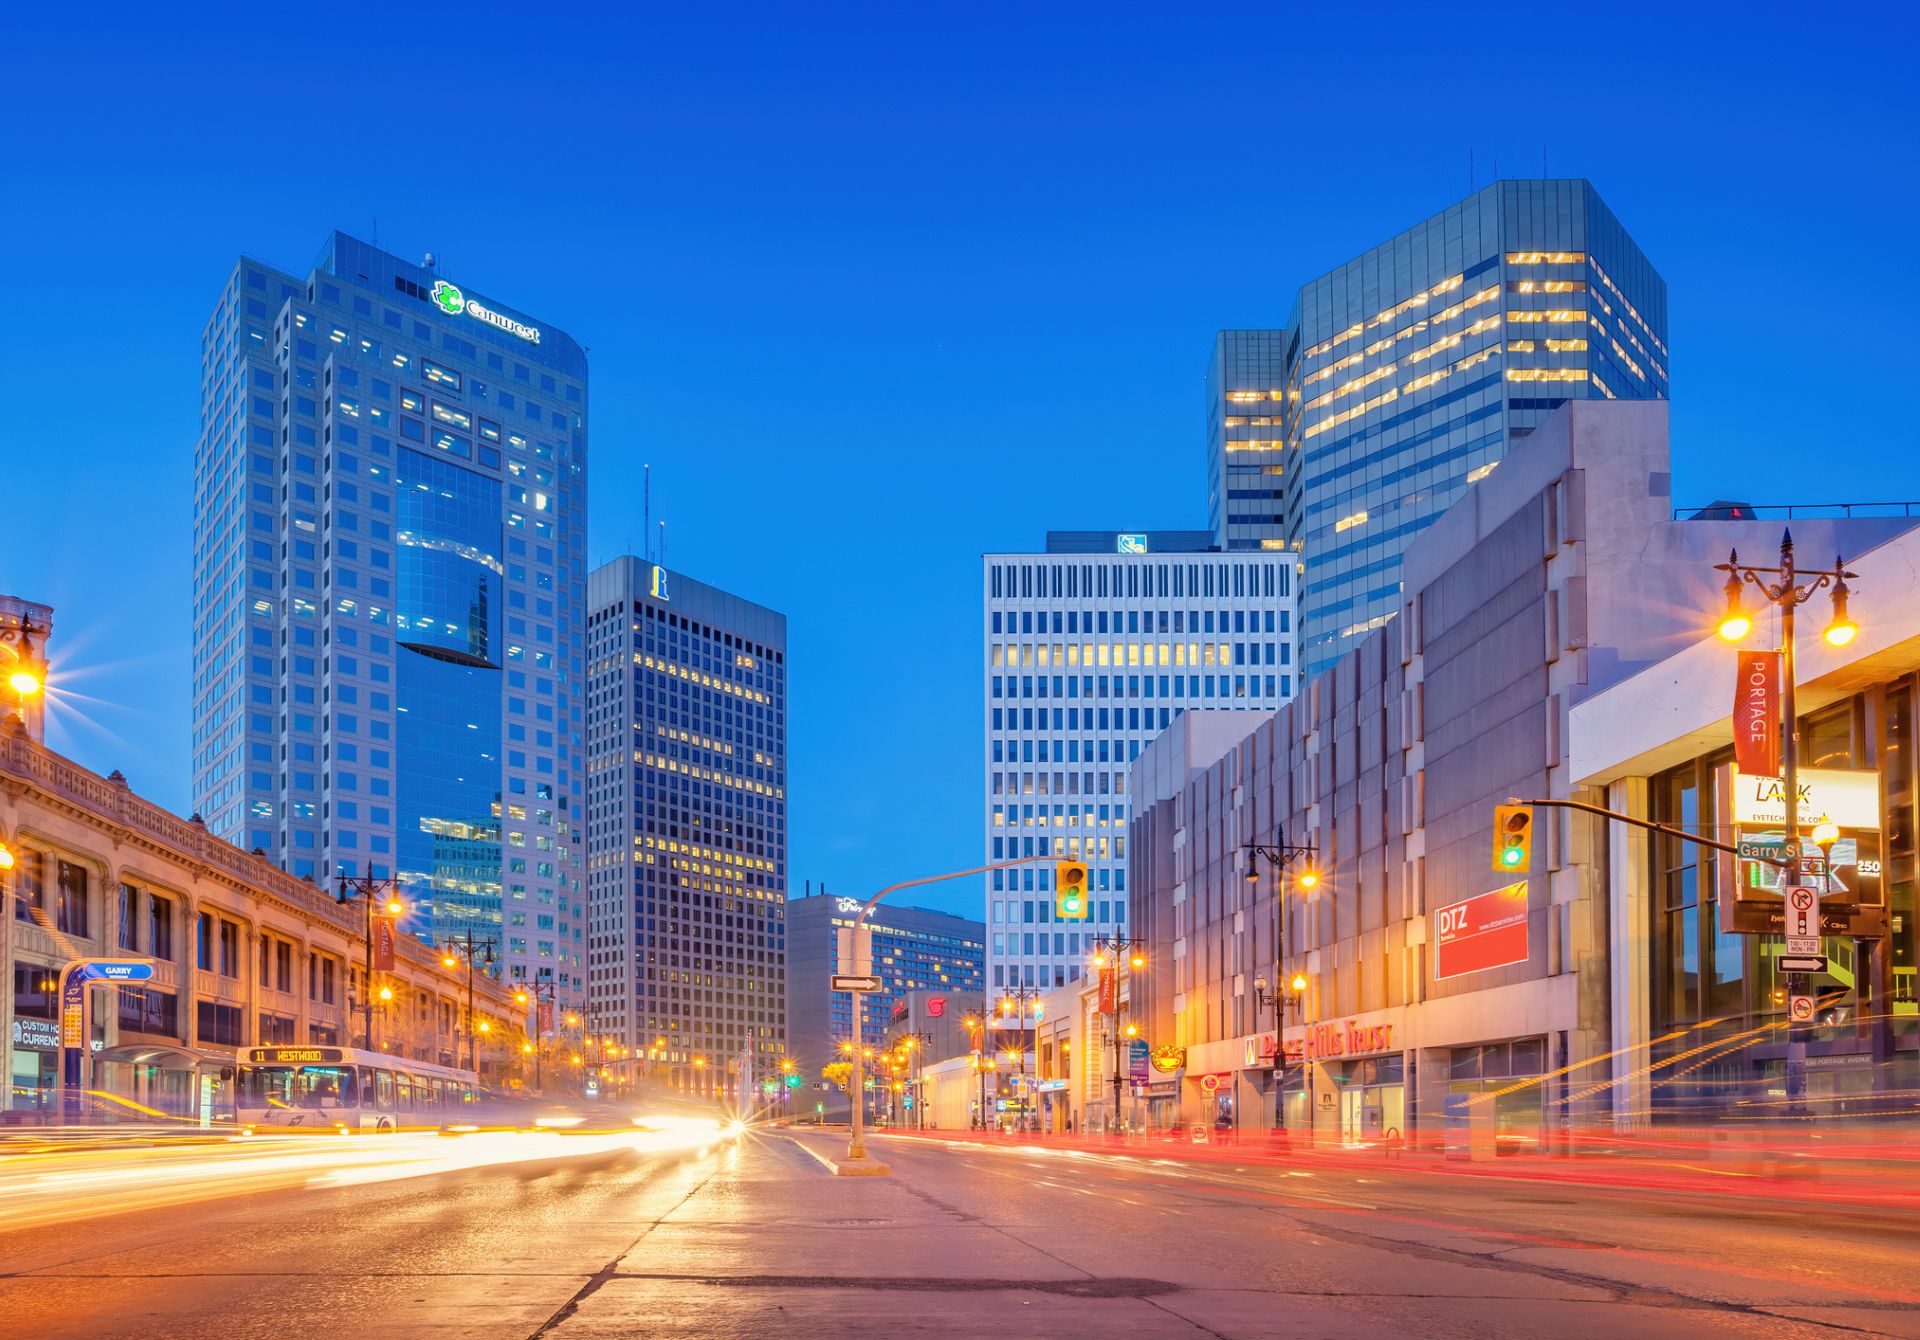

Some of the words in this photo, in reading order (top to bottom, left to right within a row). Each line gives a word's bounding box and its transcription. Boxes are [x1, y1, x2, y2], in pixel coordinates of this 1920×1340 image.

[466, 300, 541, 344] Canwest
[1750, 662, 1766, 742] PORTAGE
[1740, 844, 1779, 859] Garry
[1786, 845, 1802, 858] St
[1858, 860, 1880, 872] 250
[1441, 905, 1468, 934] DTZ
[105, 966, 132, 975] GARRY
[22, 1020, 50, 1031] CUSTOM
[22, 1033, 59, 1047] CURRENC
[256, 1050, 266, 1061] 11
[278, 1050, 322, 1062] WESTWOOD
